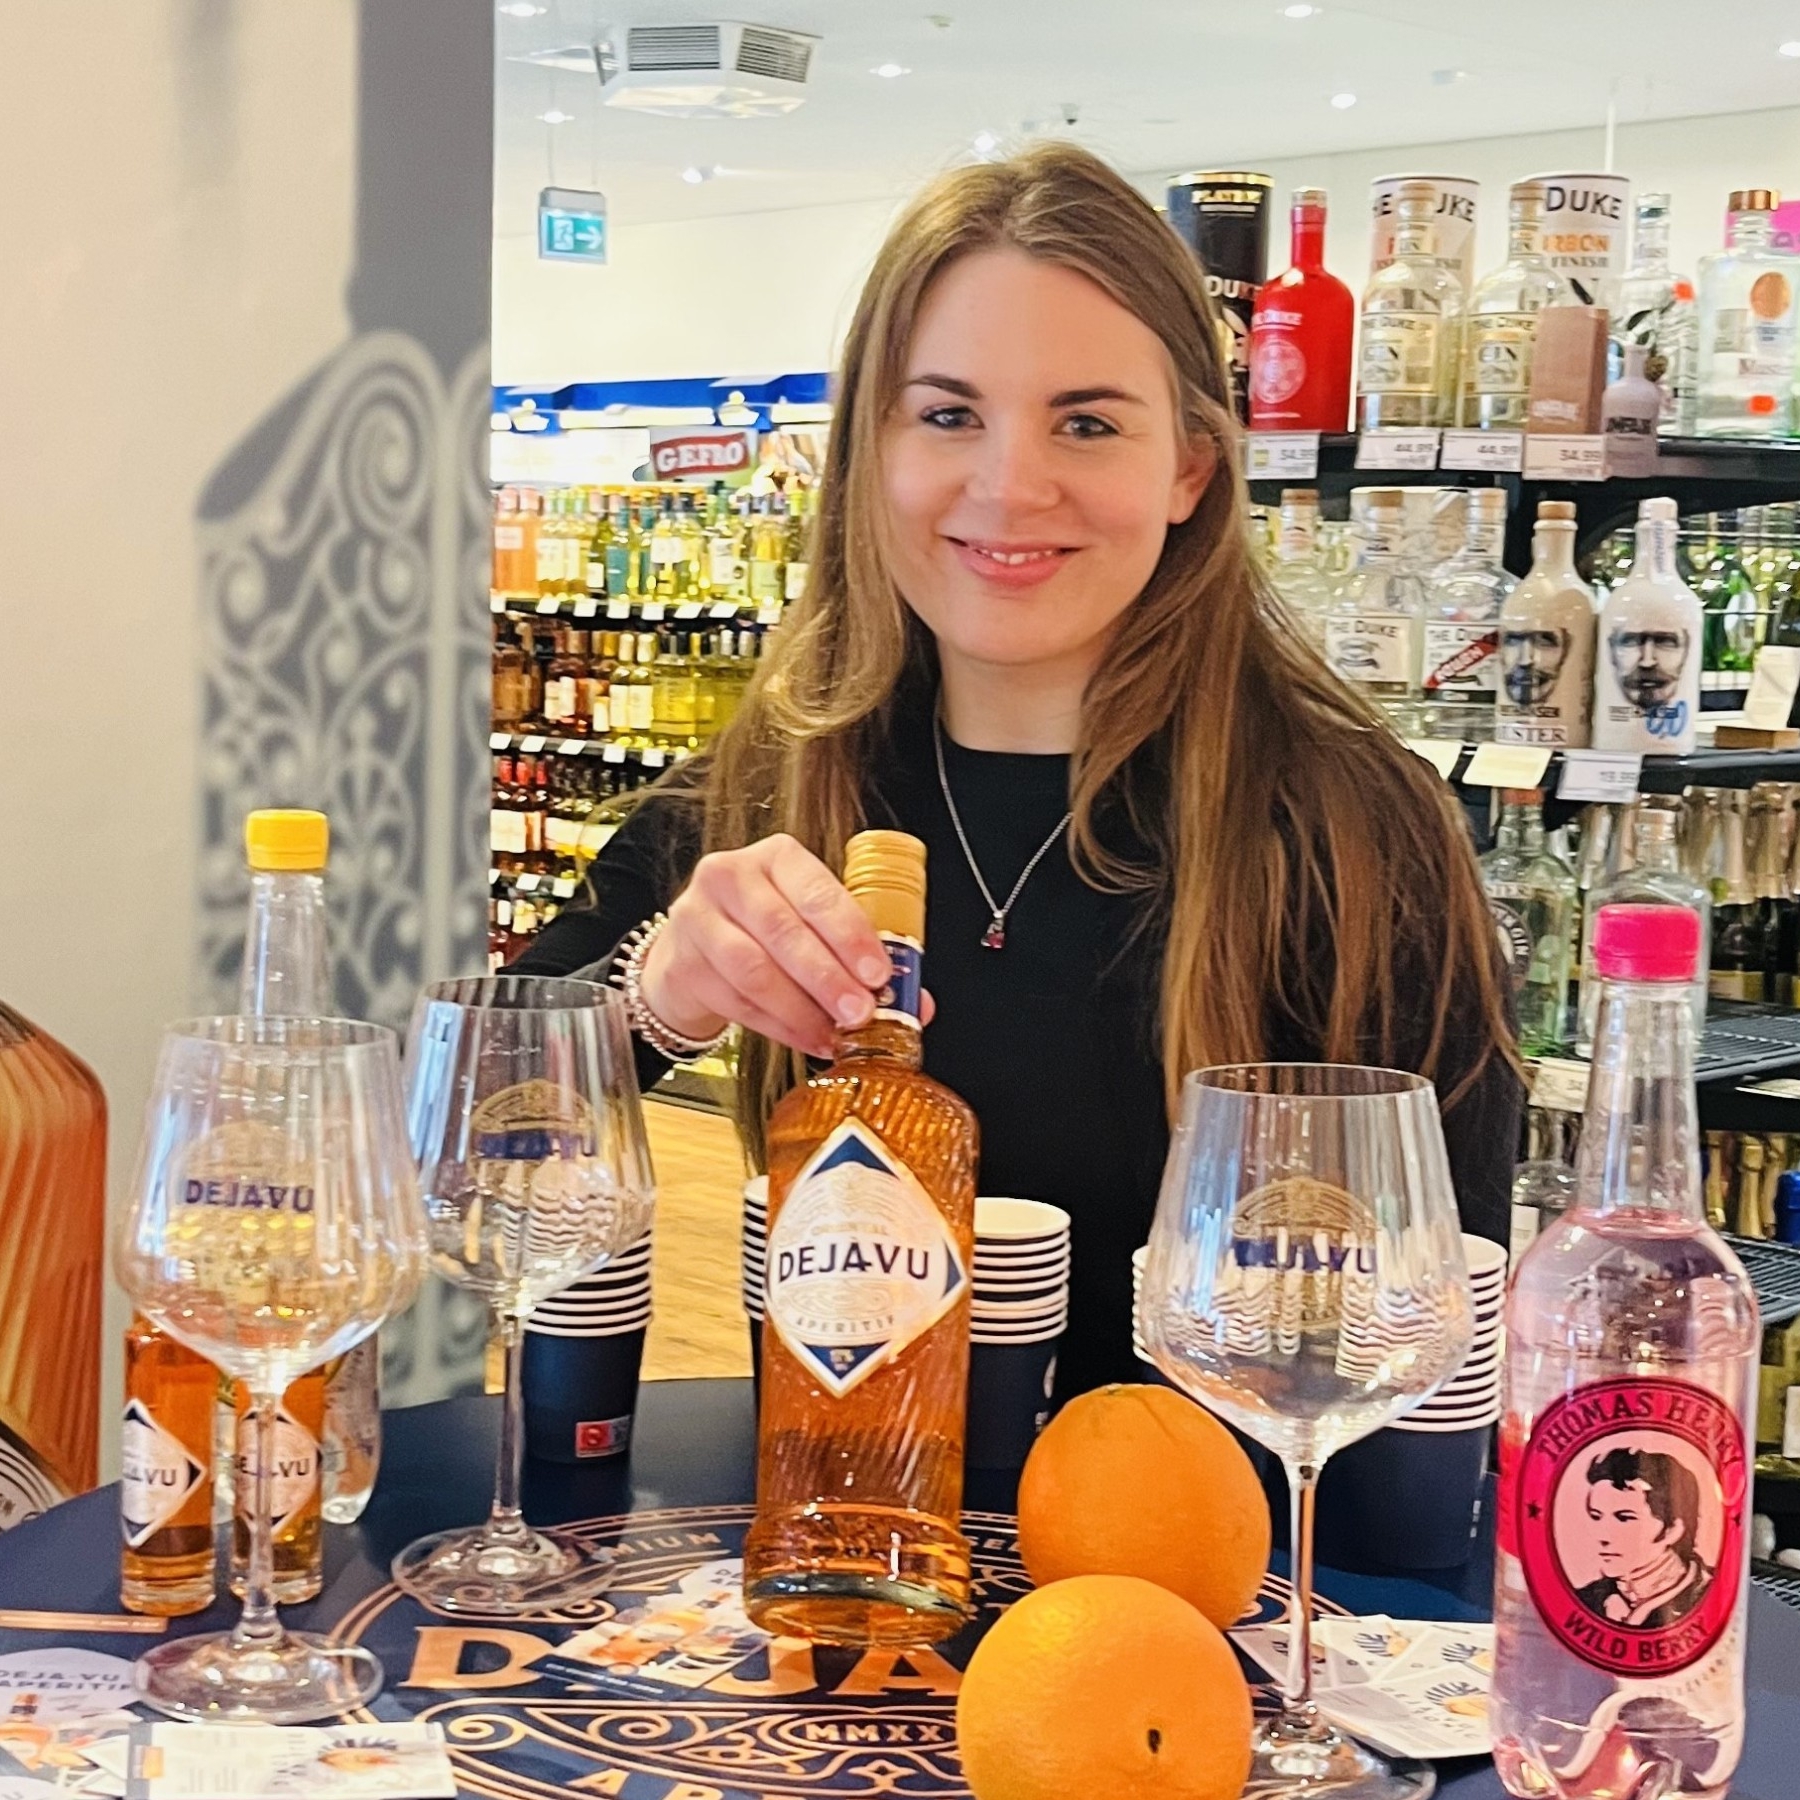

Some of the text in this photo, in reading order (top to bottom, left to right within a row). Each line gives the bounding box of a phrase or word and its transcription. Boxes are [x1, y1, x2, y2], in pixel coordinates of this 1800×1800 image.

[1546, 186, 1622, 220] DUKE
[655, 442, 745, 474] GEFRO
[1354, 620, 1399, 638] DUKE
[1539, 1391, 1654, 1463] THOMAS
[1563, 1610, 1710, 1663] WILD BERRY
[802, 1723, 945, 1742] MMXX
